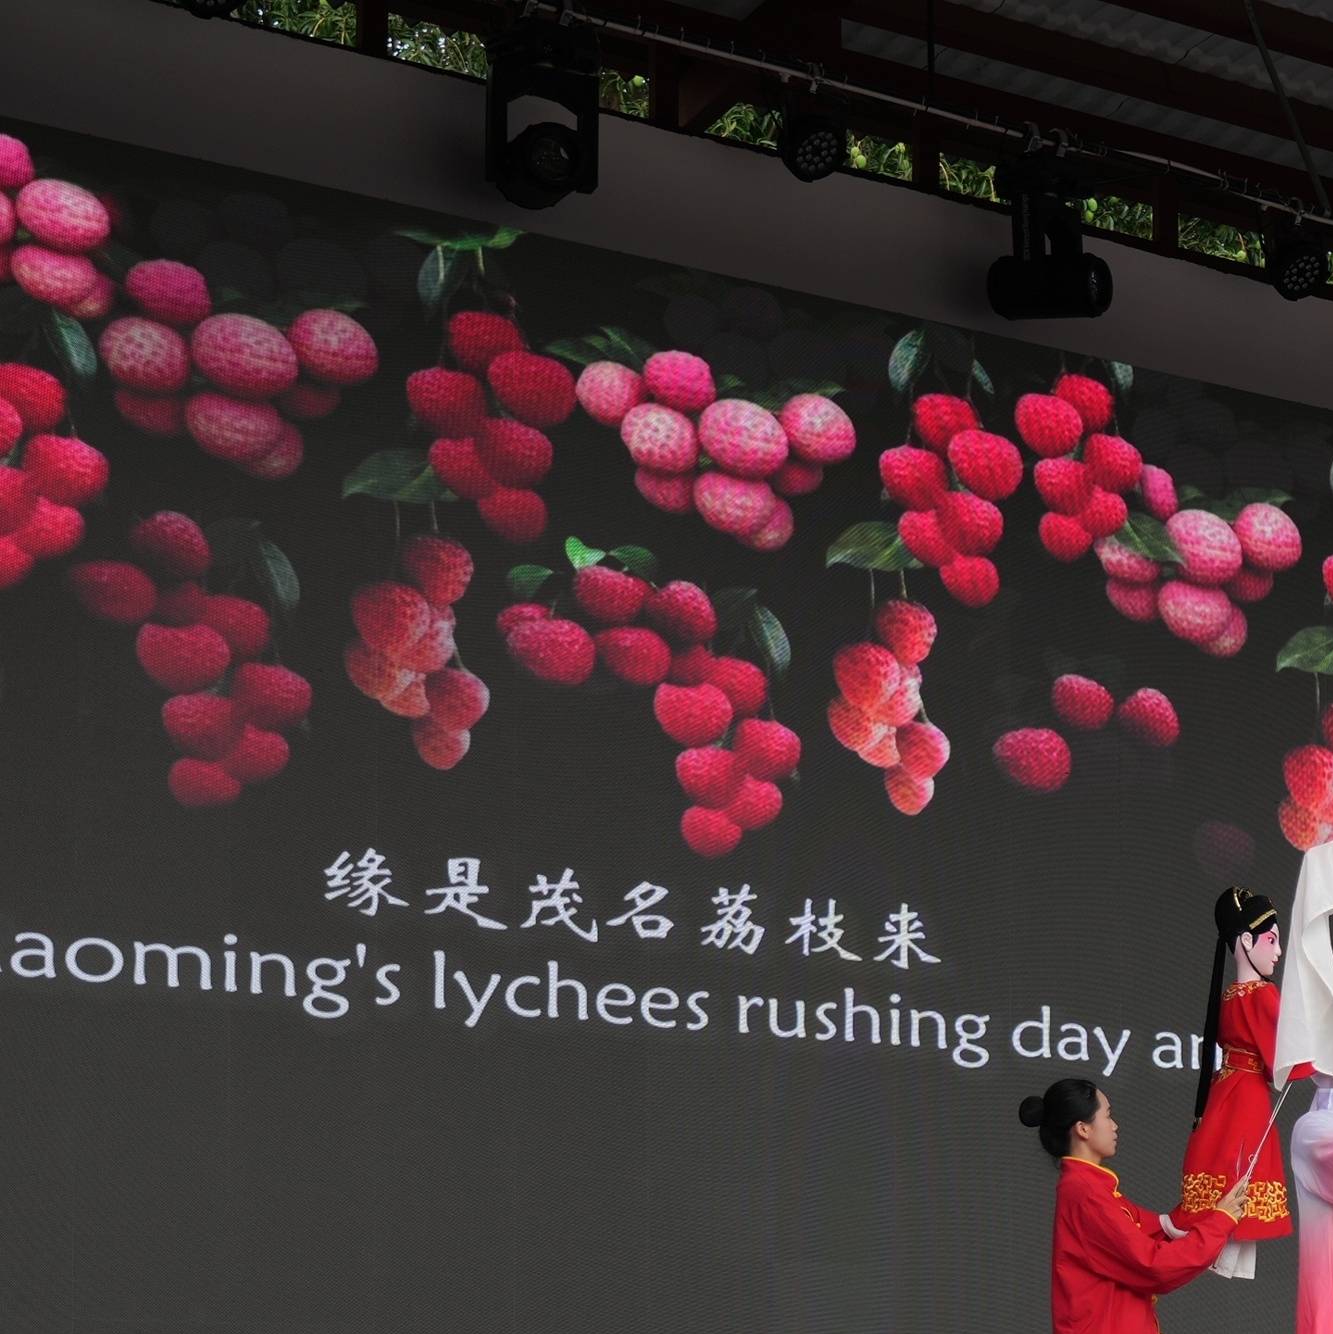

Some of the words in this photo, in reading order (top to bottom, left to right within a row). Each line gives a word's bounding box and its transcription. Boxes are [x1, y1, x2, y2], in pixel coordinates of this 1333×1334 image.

[324, 847, 942, 970] 缘是茂名荔枝来
[0, 932, 401, 1019] aoming's
[433, 949, 711, 1031] lychees
[737, 986, 991, 1070] rushing
[1011, 1005, 1132, 1078] day
[1152, 1030, 1224, 1072] an
